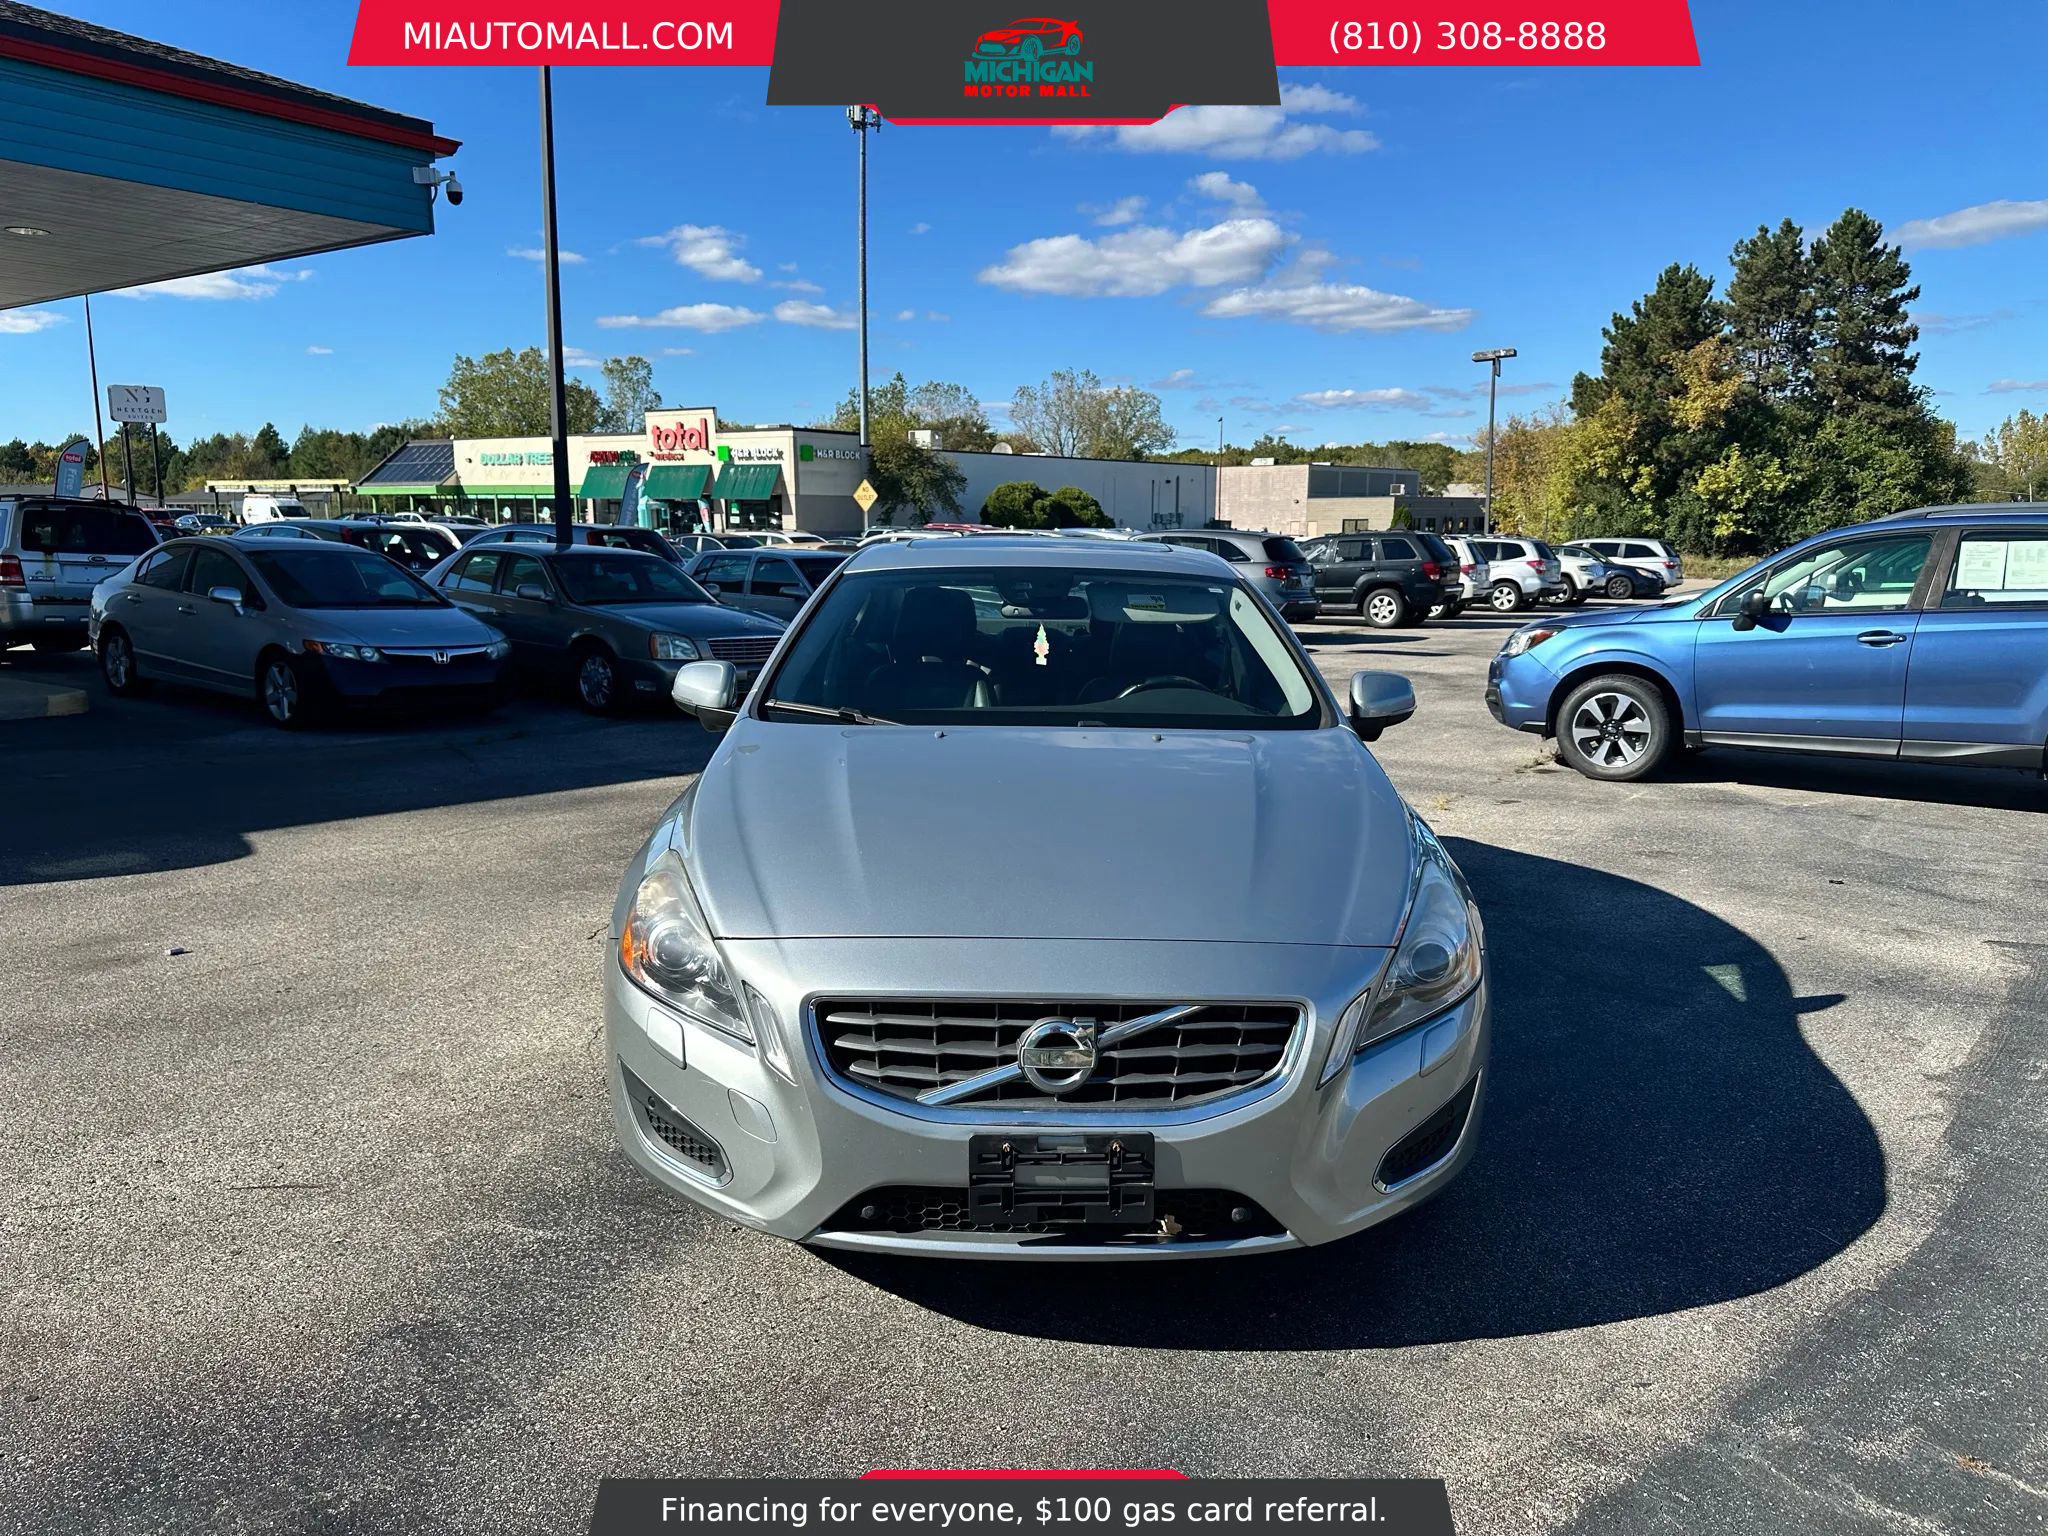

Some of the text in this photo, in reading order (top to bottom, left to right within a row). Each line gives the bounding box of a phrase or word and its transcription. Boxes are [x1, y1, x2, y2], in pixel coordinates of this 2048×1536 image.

[652, 418, 707, 450] total
[731, 447, 779, 458] H&R BLOCK
[817, 449, 860, 460] H&R BLOCK
[480, 452, 553, 466] DOLLAR TREE
